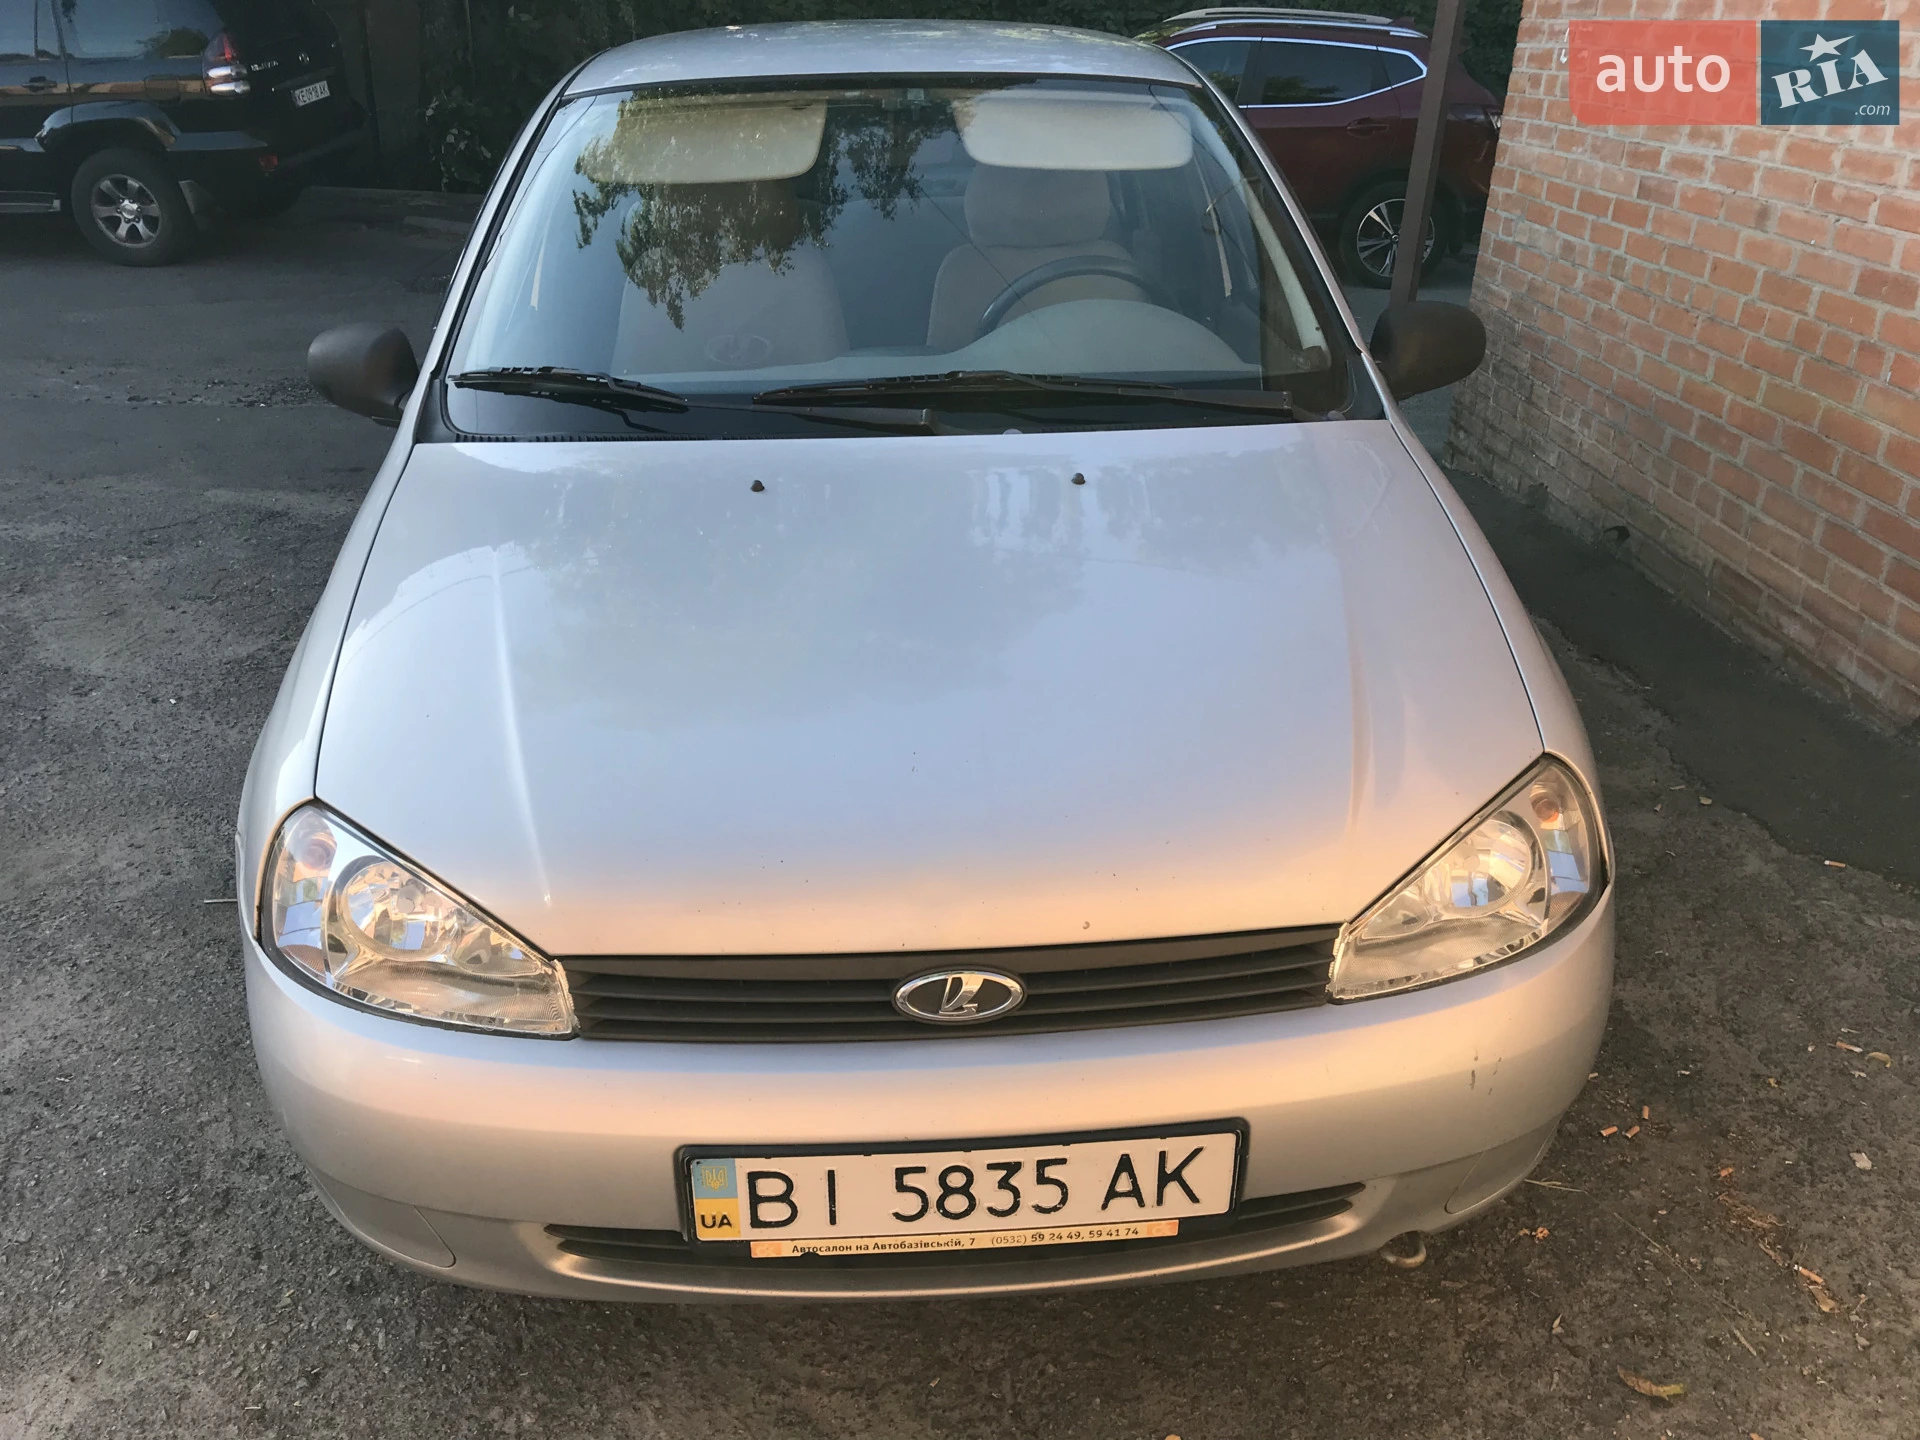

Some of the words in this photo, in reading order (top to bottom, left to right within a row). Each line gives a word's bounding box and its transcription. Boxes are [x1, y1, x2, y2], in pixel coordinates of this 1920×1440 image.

[747, 1169, 838, 1229] BI
[891, 1157, 1070, 1223] 5835
[1100, 1146, 1205, 1211] AK
[700, 1213, 732, 1228] UA
[791, 1244, 852, 1254] Автосалон
[855, 1243, 870, 1252] на
[969, 1237, 976, 1246] 7
[991, 1235, 1027, 1246] (0532)
[1030, 1233, 1045, 1243] 59
[1049, 1231, 1063, 1241] 24
[1066, 1230, 1085, 1240] 49,
[1088, 1229, 1103, 1239] 59
[1106, 1229, 1120, 1237] 41
[1124, 1227, 1139, 1236] 74
